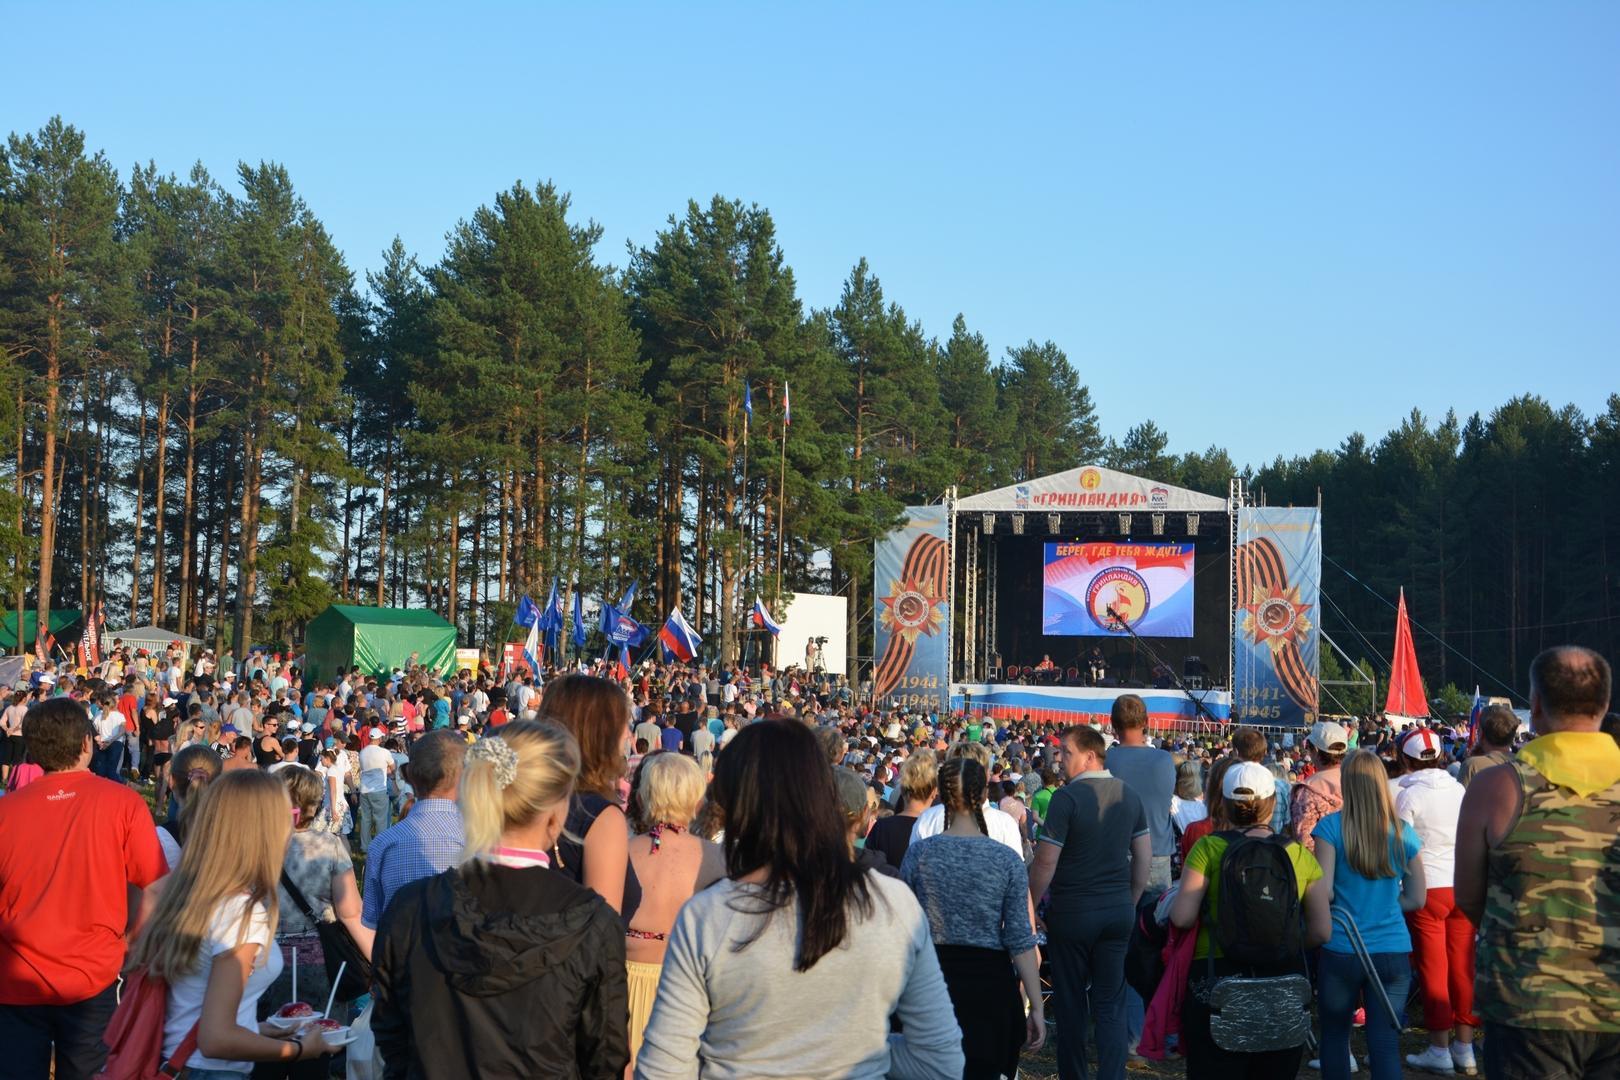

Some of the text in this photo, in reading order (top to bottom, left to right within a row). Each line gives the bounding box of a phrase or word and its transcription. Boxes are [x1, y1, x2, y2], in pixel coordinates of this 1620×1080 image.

[1033, 492, 1147, 508] «ГРИНЛАНДИЯ»
[1056, 545, 1182, 558] БЕРЕГ, ГДЕ ТЕБЯ ЖДУТ!
[1092, 573, 1138, 593] ГРИНЛАНДИЯ
[901, 694, 940, 706] 1945
[1241, 704, 1281, 719] 1945
